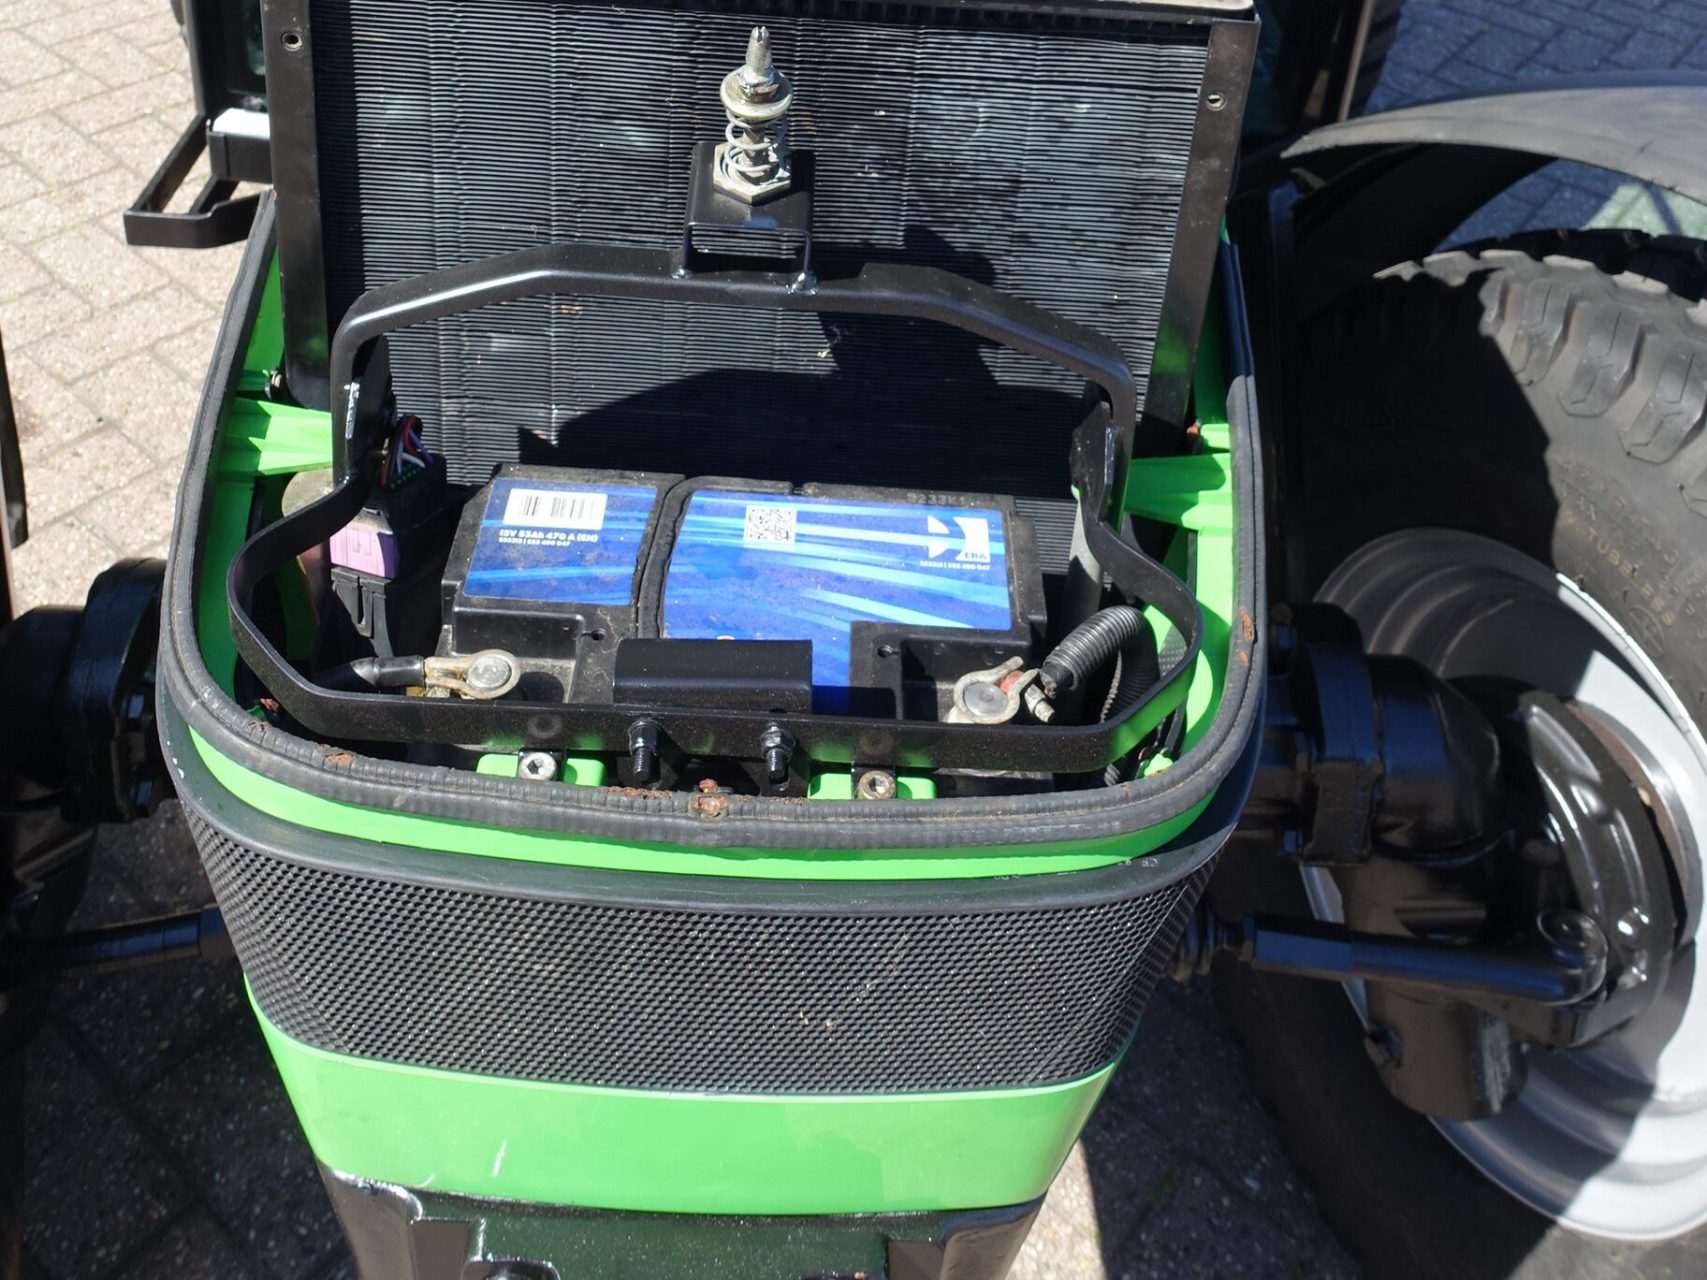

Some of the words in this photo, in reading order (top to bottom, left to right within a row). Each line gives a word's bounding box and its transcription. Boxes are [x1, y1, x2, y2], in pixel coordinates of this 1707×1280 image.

[499, 529, 517, 537] 12V
[519, 529, 545, 539] 53Ah
[545, 531, 566, 540] 470
[568, 533, 576, 541] A
[577, 533, 599, 543] (EN)
[965, 552, 987, 560] ERA
